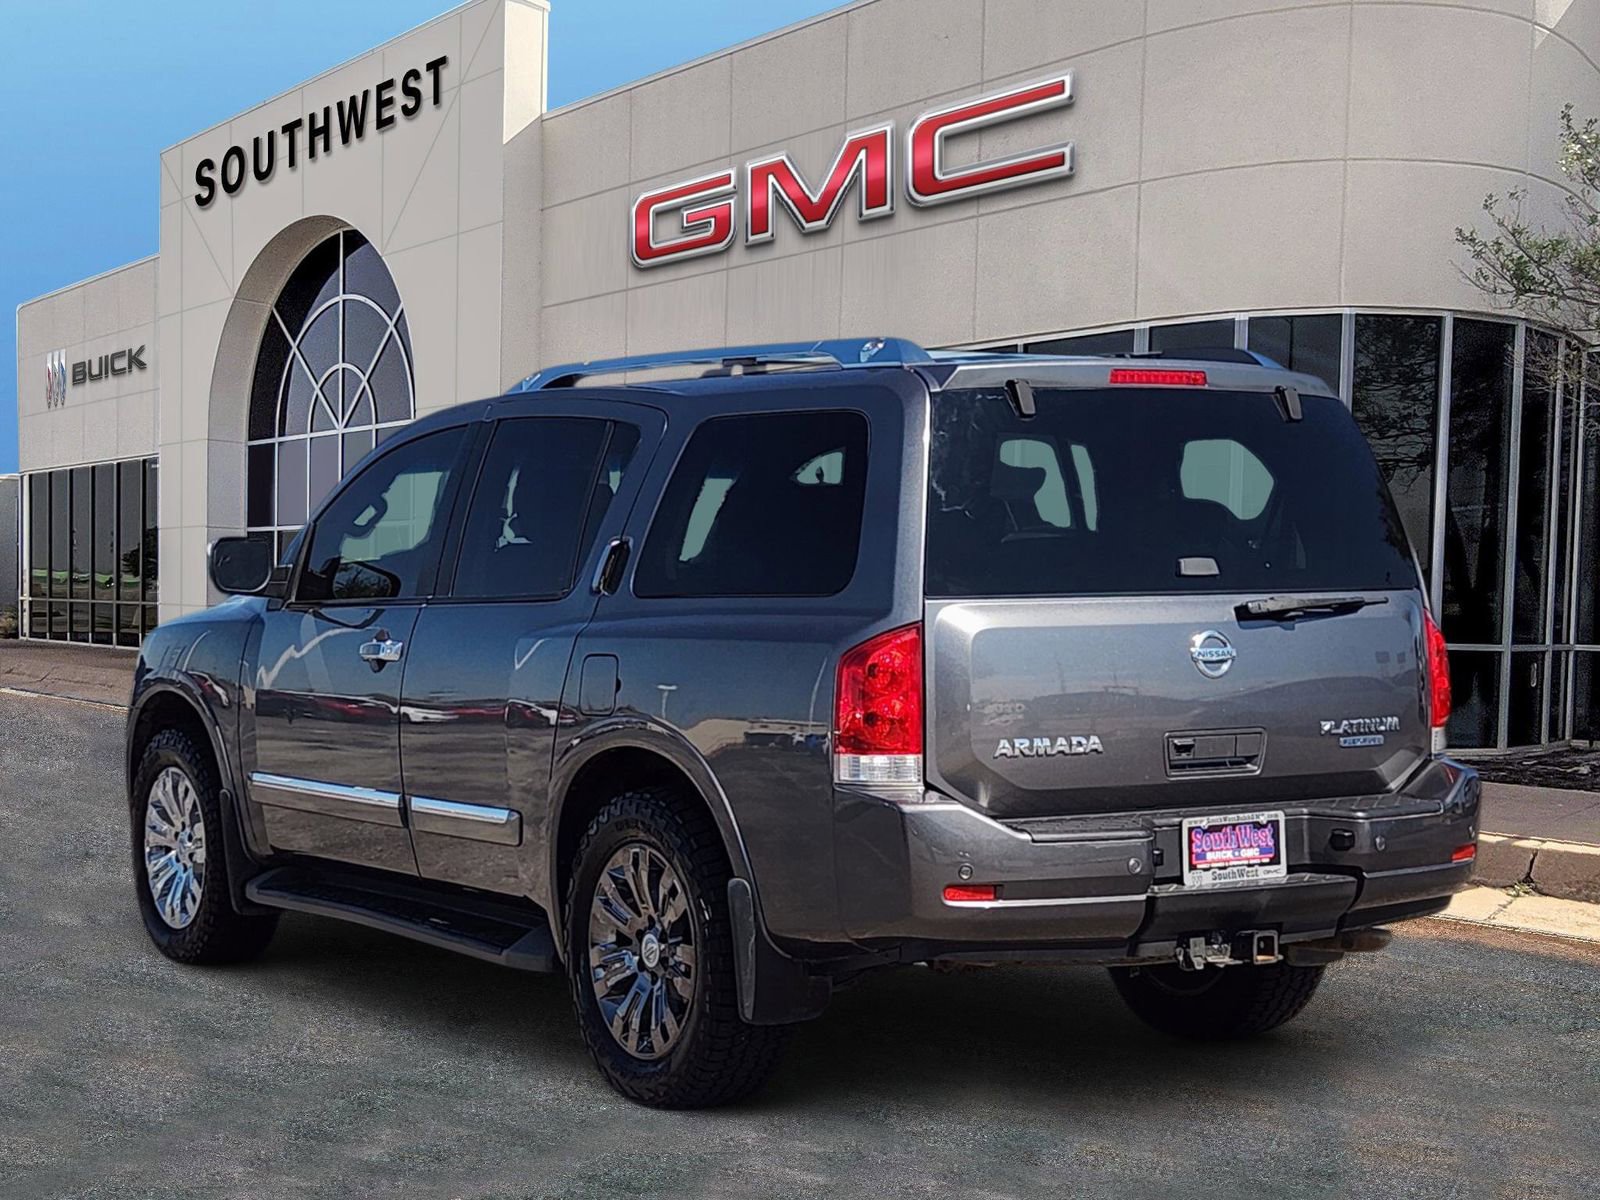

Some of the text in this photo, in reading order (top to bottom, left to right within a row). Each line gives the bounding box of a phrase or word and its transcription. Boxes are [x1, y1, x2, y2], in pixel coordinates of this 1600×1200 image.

[195, 55, 447, 206] SOUTHWEST
[631, 69, 1075, 268] GMC
[72, 344, 147, 386] BUICK
[1196, 649, 1233, 658] NISSAN
[1319, 716, 1400, 735] PLATINUM
[992, 735, 1104, 759] ARMADA
